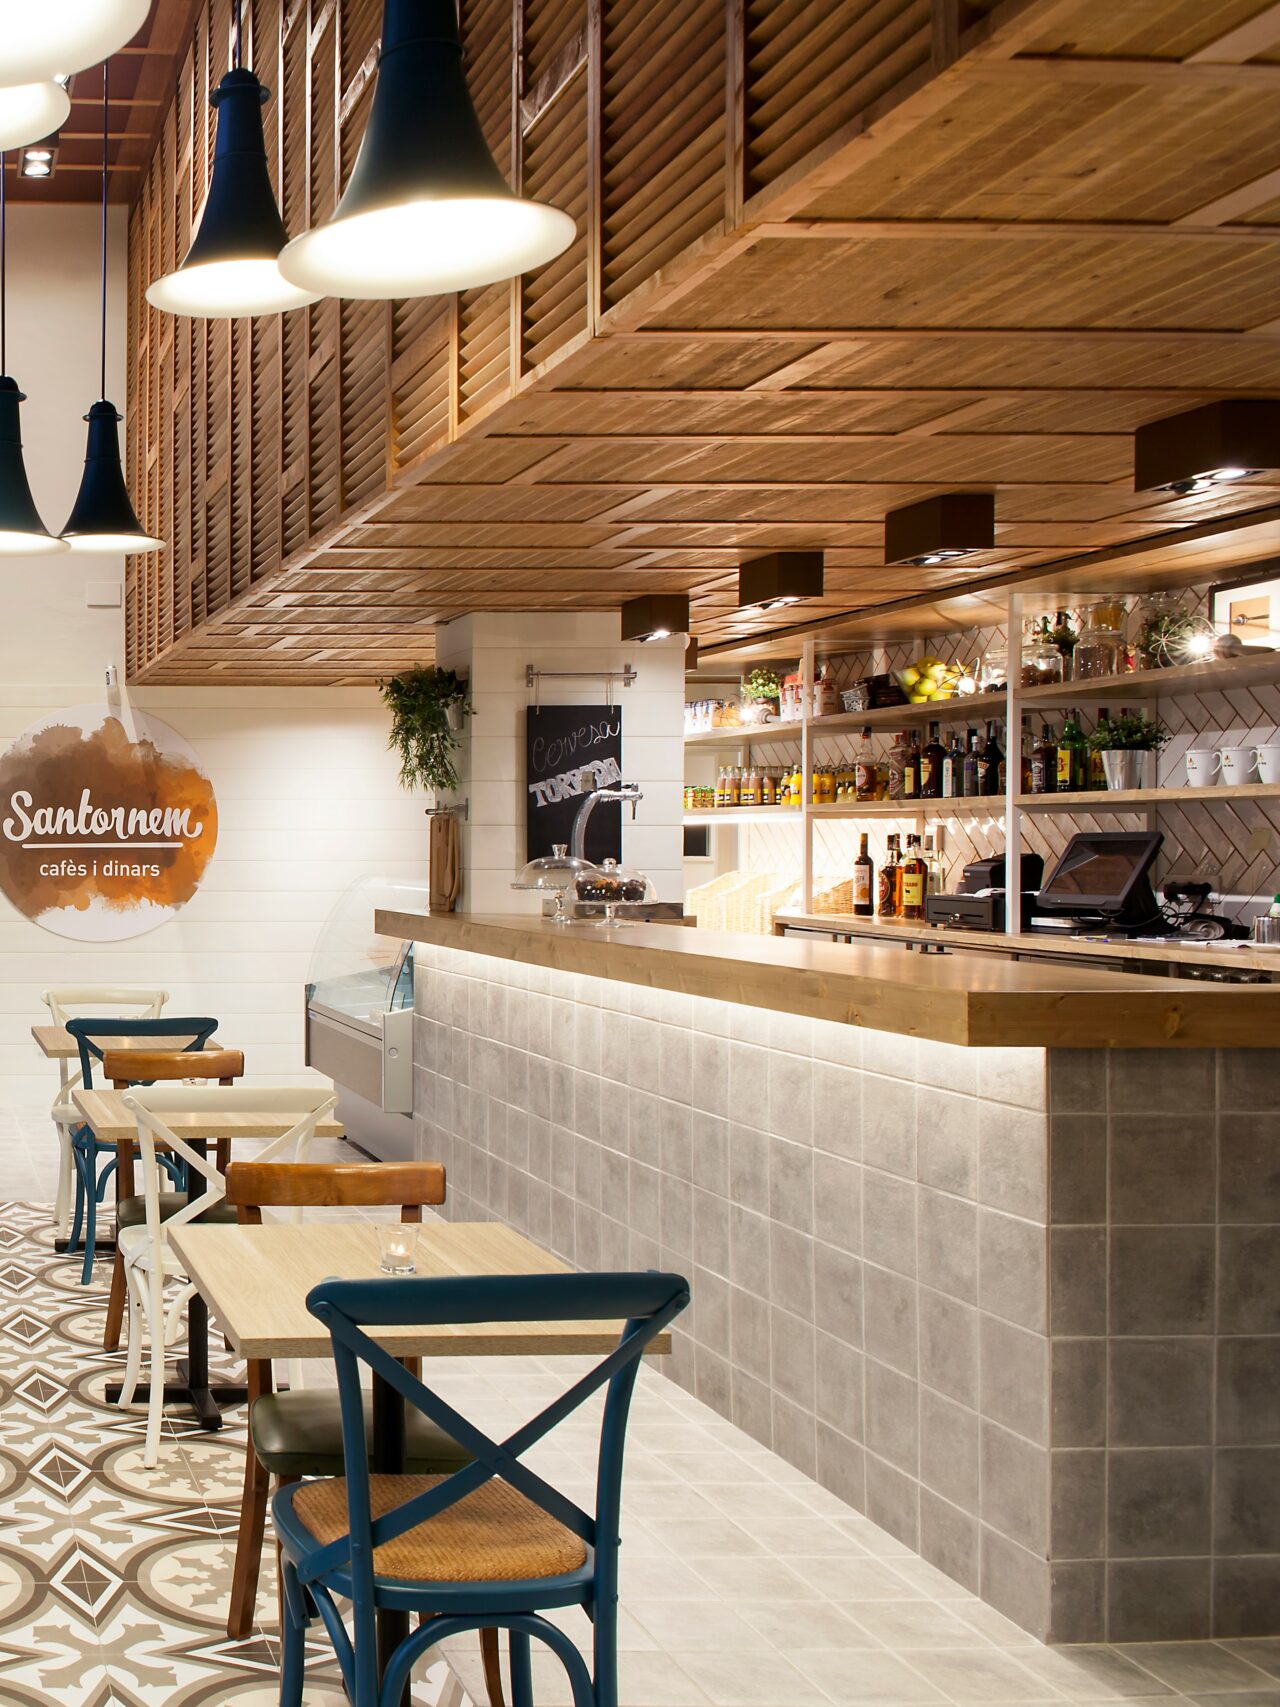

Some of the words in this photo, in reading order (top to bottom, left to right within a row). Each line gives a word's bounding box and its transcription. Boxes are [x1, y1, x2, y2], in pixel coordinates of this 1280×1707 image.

[3, 788, 203, 841] Santornem
[39, 859, 87, 877] cafès
[93, 860, 97, 876] i
[103, 860, 160, 877] dinars
